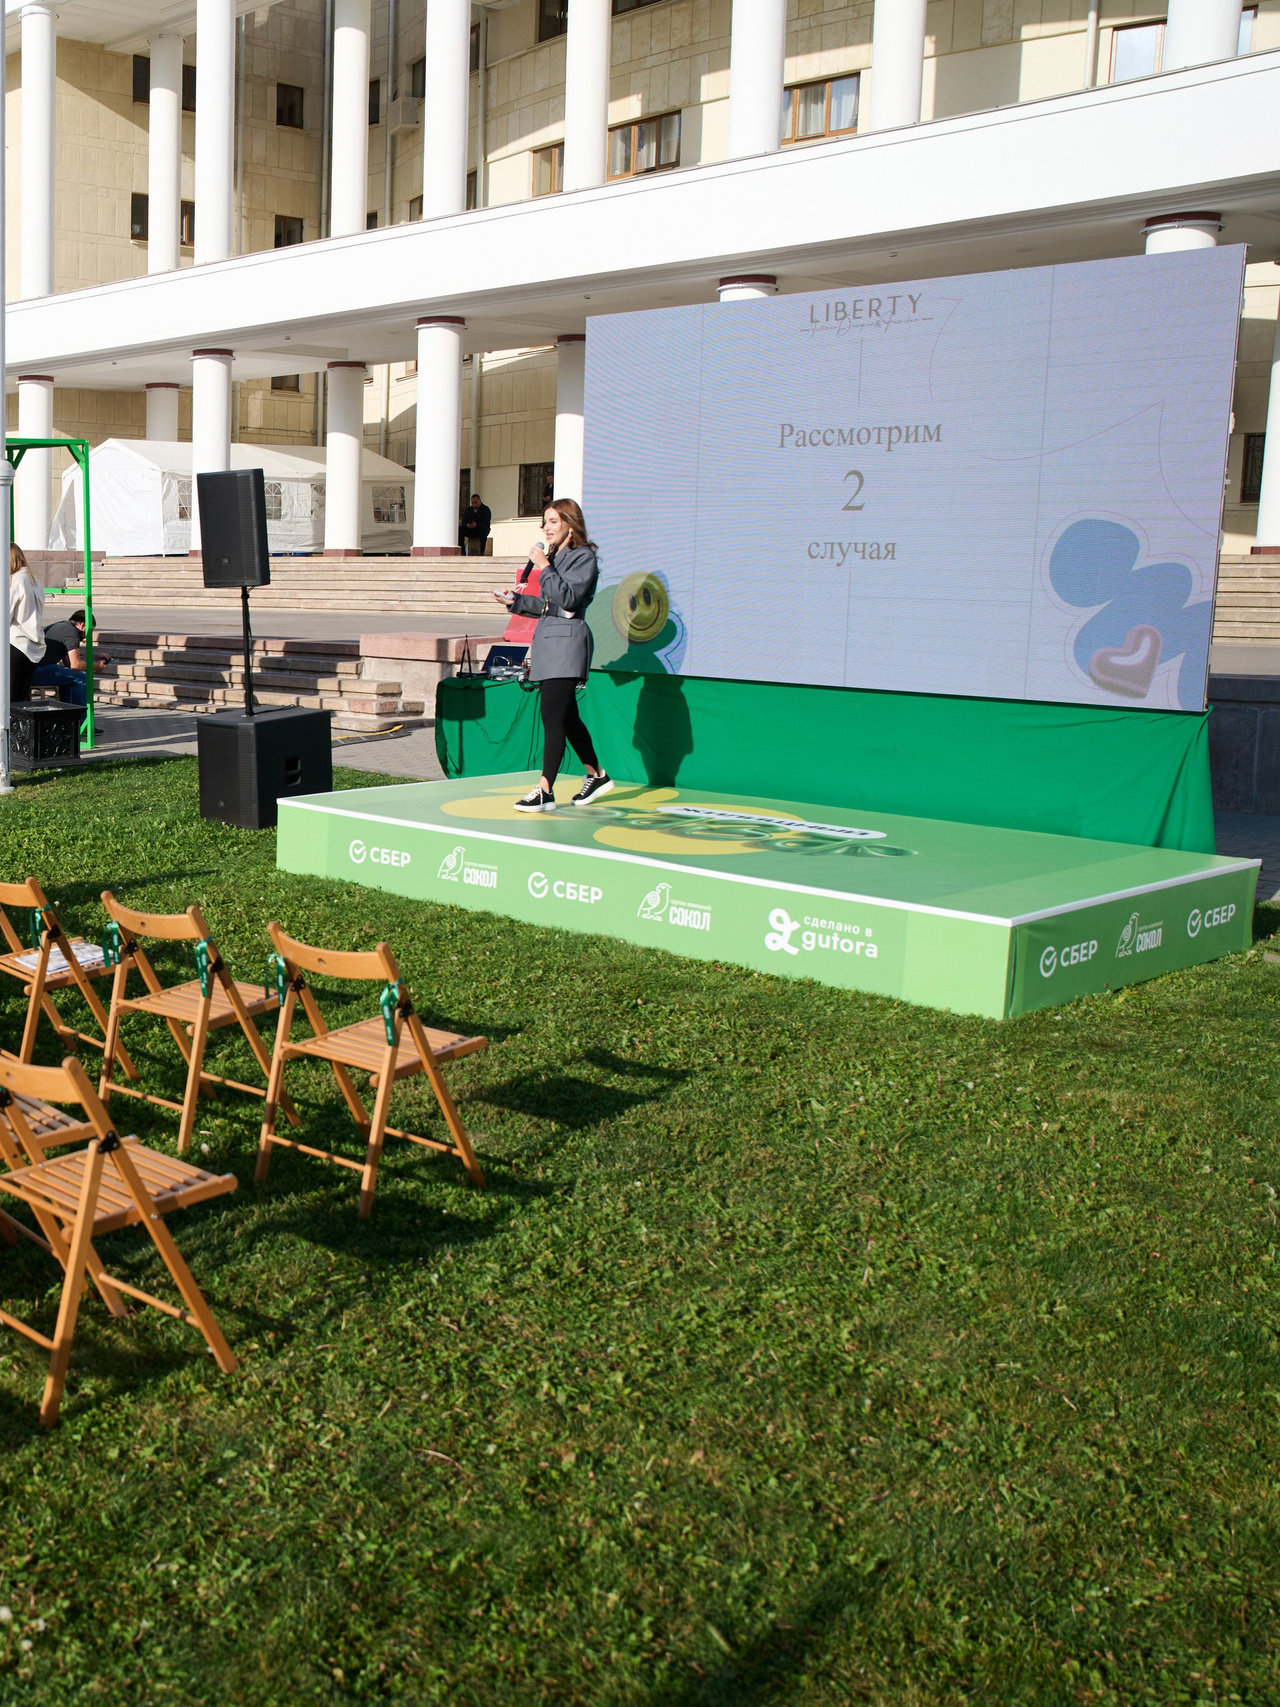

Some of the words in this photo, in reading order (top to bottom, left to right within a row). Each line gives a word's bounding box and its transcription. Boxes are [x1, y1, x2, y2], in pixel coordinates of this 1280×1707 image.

[810, 293, 922, 323] LIBERTY
[778, 423, 942, 452] Рассмотрим
[841, 469, 866, 511] 2
[807, 541, 897, 567] случая
[370, 846, 411, 868] СБЕР
[463, 867, 498, 888] СОКОЛ
[553, 880, 603, 905] СБЕР
[669, 906, 711, 931] СОКОЛ
[803, 916, 860, 934] сделано
[865, 928, 873, 937] в
[1204, 903, 1236, 928] СБЕР
[801, 931, 878, 958] gutora
[1136, 928, 1163, 953] СОКОЛ
[1060, 940, 1098, 967] СБЕР
